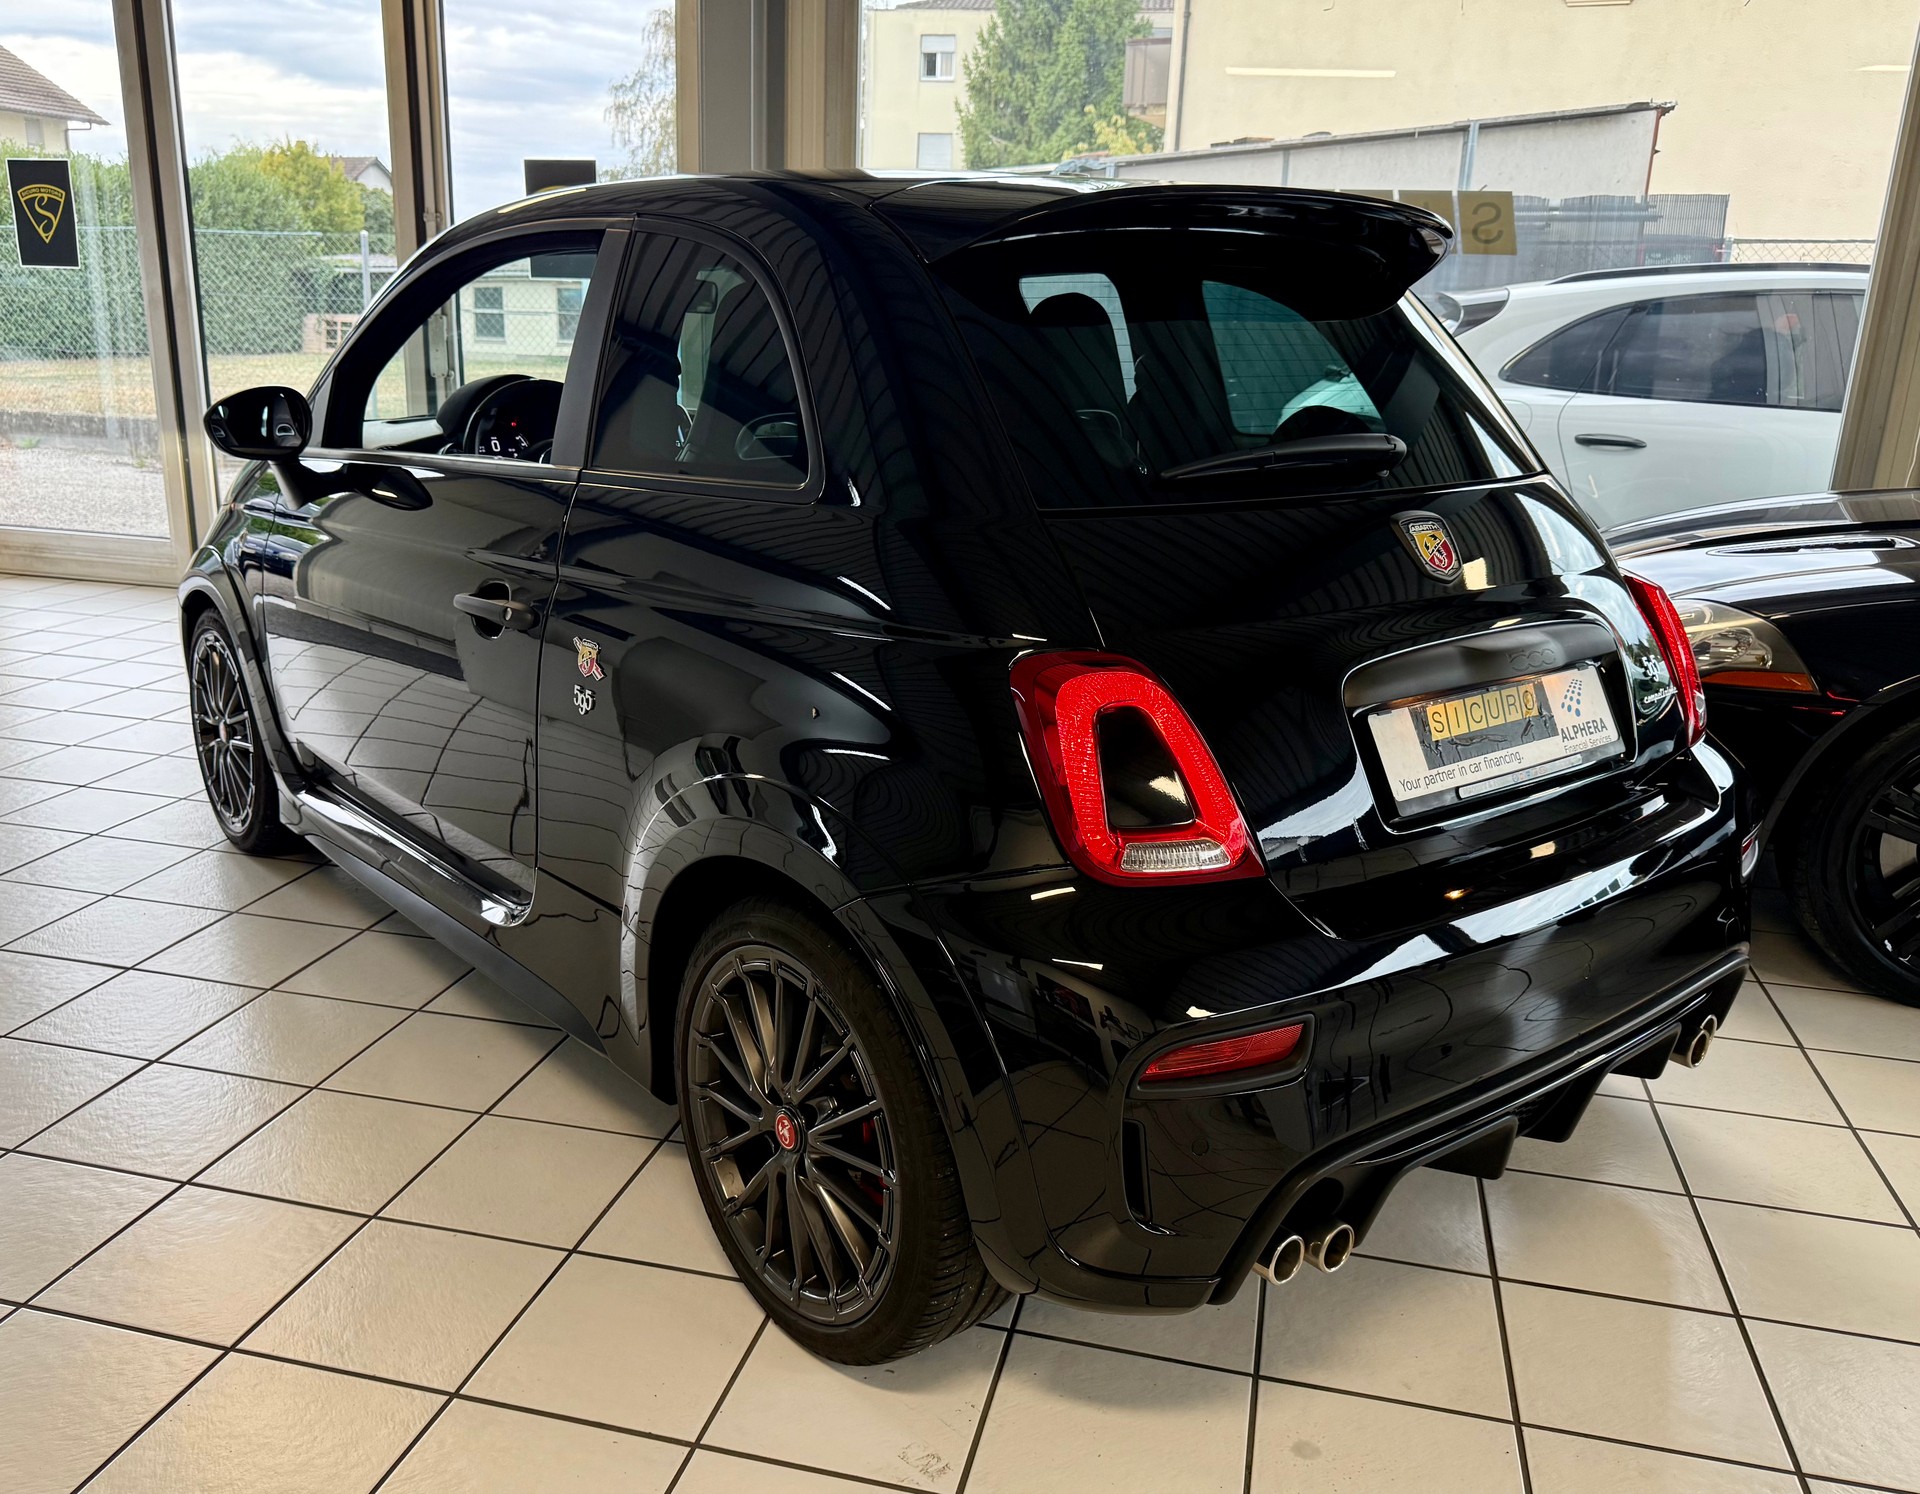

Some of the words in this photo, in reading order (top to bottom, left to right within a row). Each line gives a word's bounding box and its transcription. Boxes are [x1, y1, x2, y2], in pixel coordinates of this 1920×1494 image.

[1411, 524, 1438, 532] ABARTH
[573, 684, 592, 715] 595
[1431, 690, 1535, 733] SICURO
[1560, 717, 1608, 743] ALPHERA
[1563, 740, 1589, 754] Financial
[1589, 735, 1612, 748] Services
[1399, 779, 1422, 793] Your
[1423, 771, 1456, 789] partner
[1458, 766, 1468, 777] in
[1469, 761, 1483, 773] car
[1484, 750, 1525, 770] financing.
